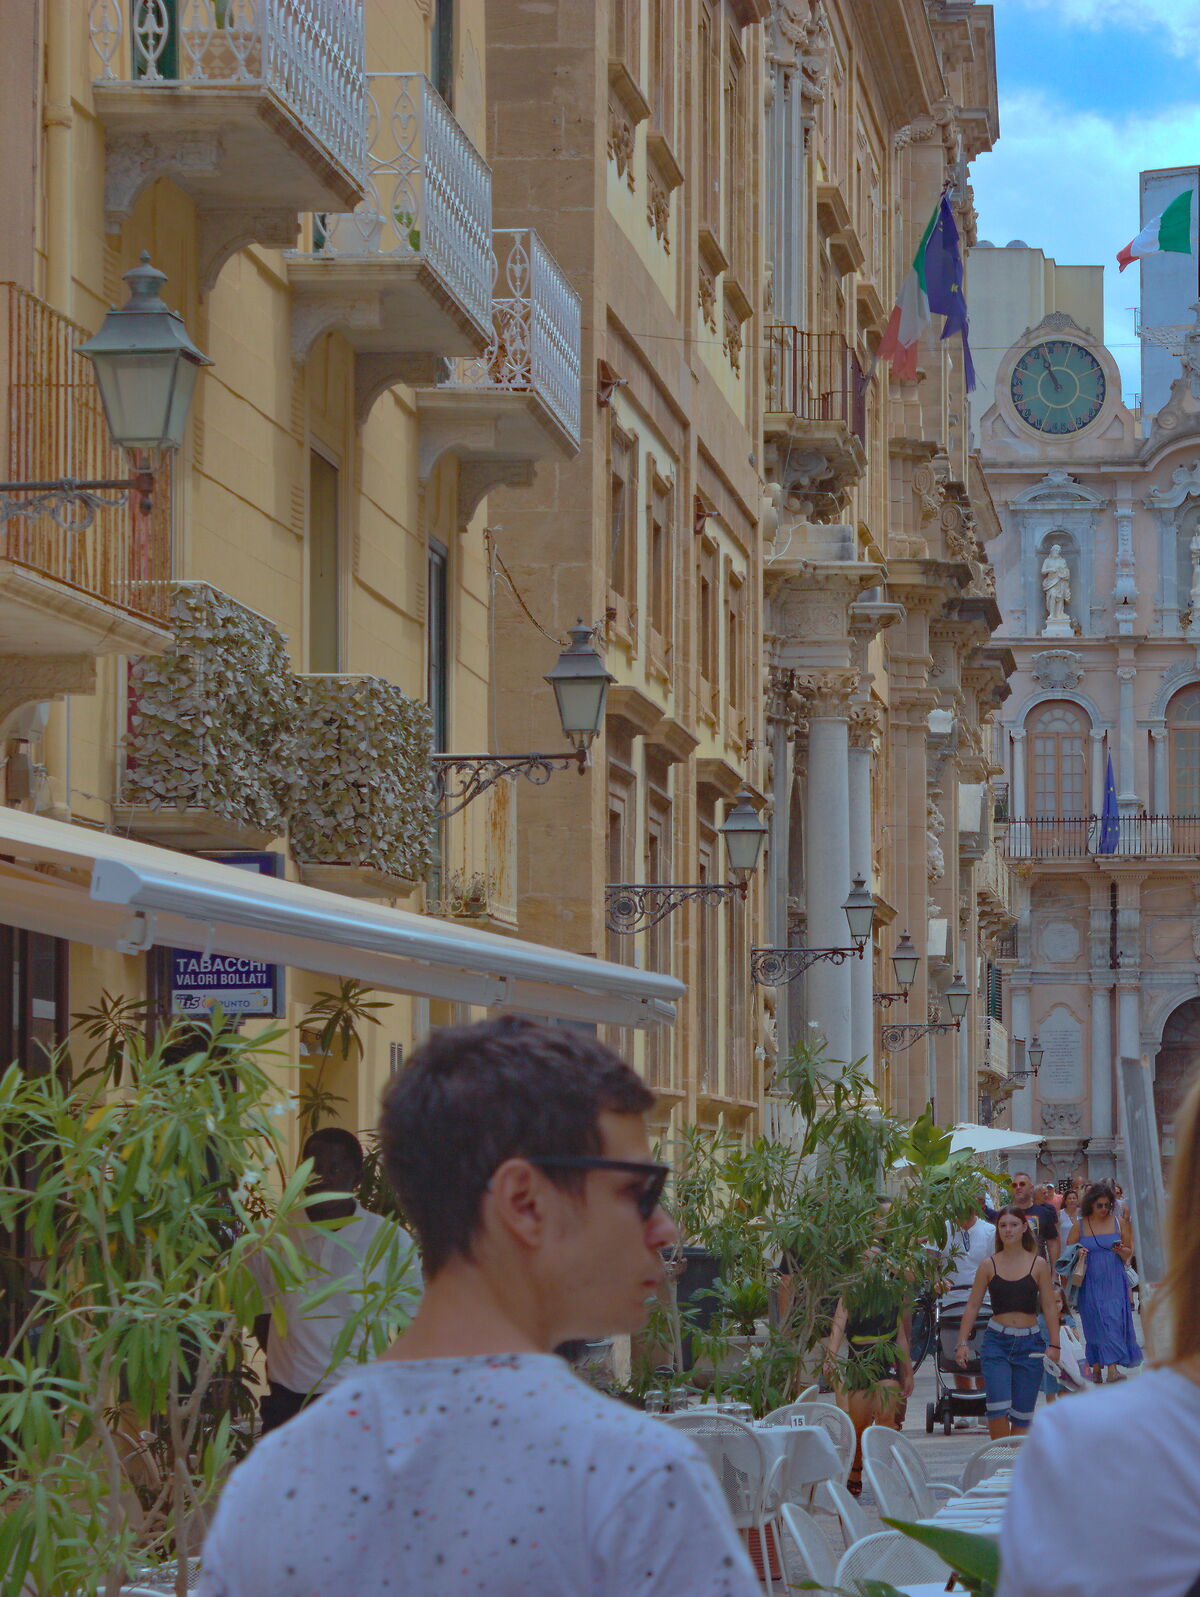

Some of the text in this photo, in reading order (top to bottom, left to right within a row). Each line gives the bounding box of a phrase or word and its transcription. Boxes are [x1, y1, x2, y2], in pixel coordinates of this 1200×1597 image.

[176, 958, 267, 972] TABACCHI
[176, 973, 267, 985] VALORI BOLLATI
[793, 1418, 803, 1426] 15
